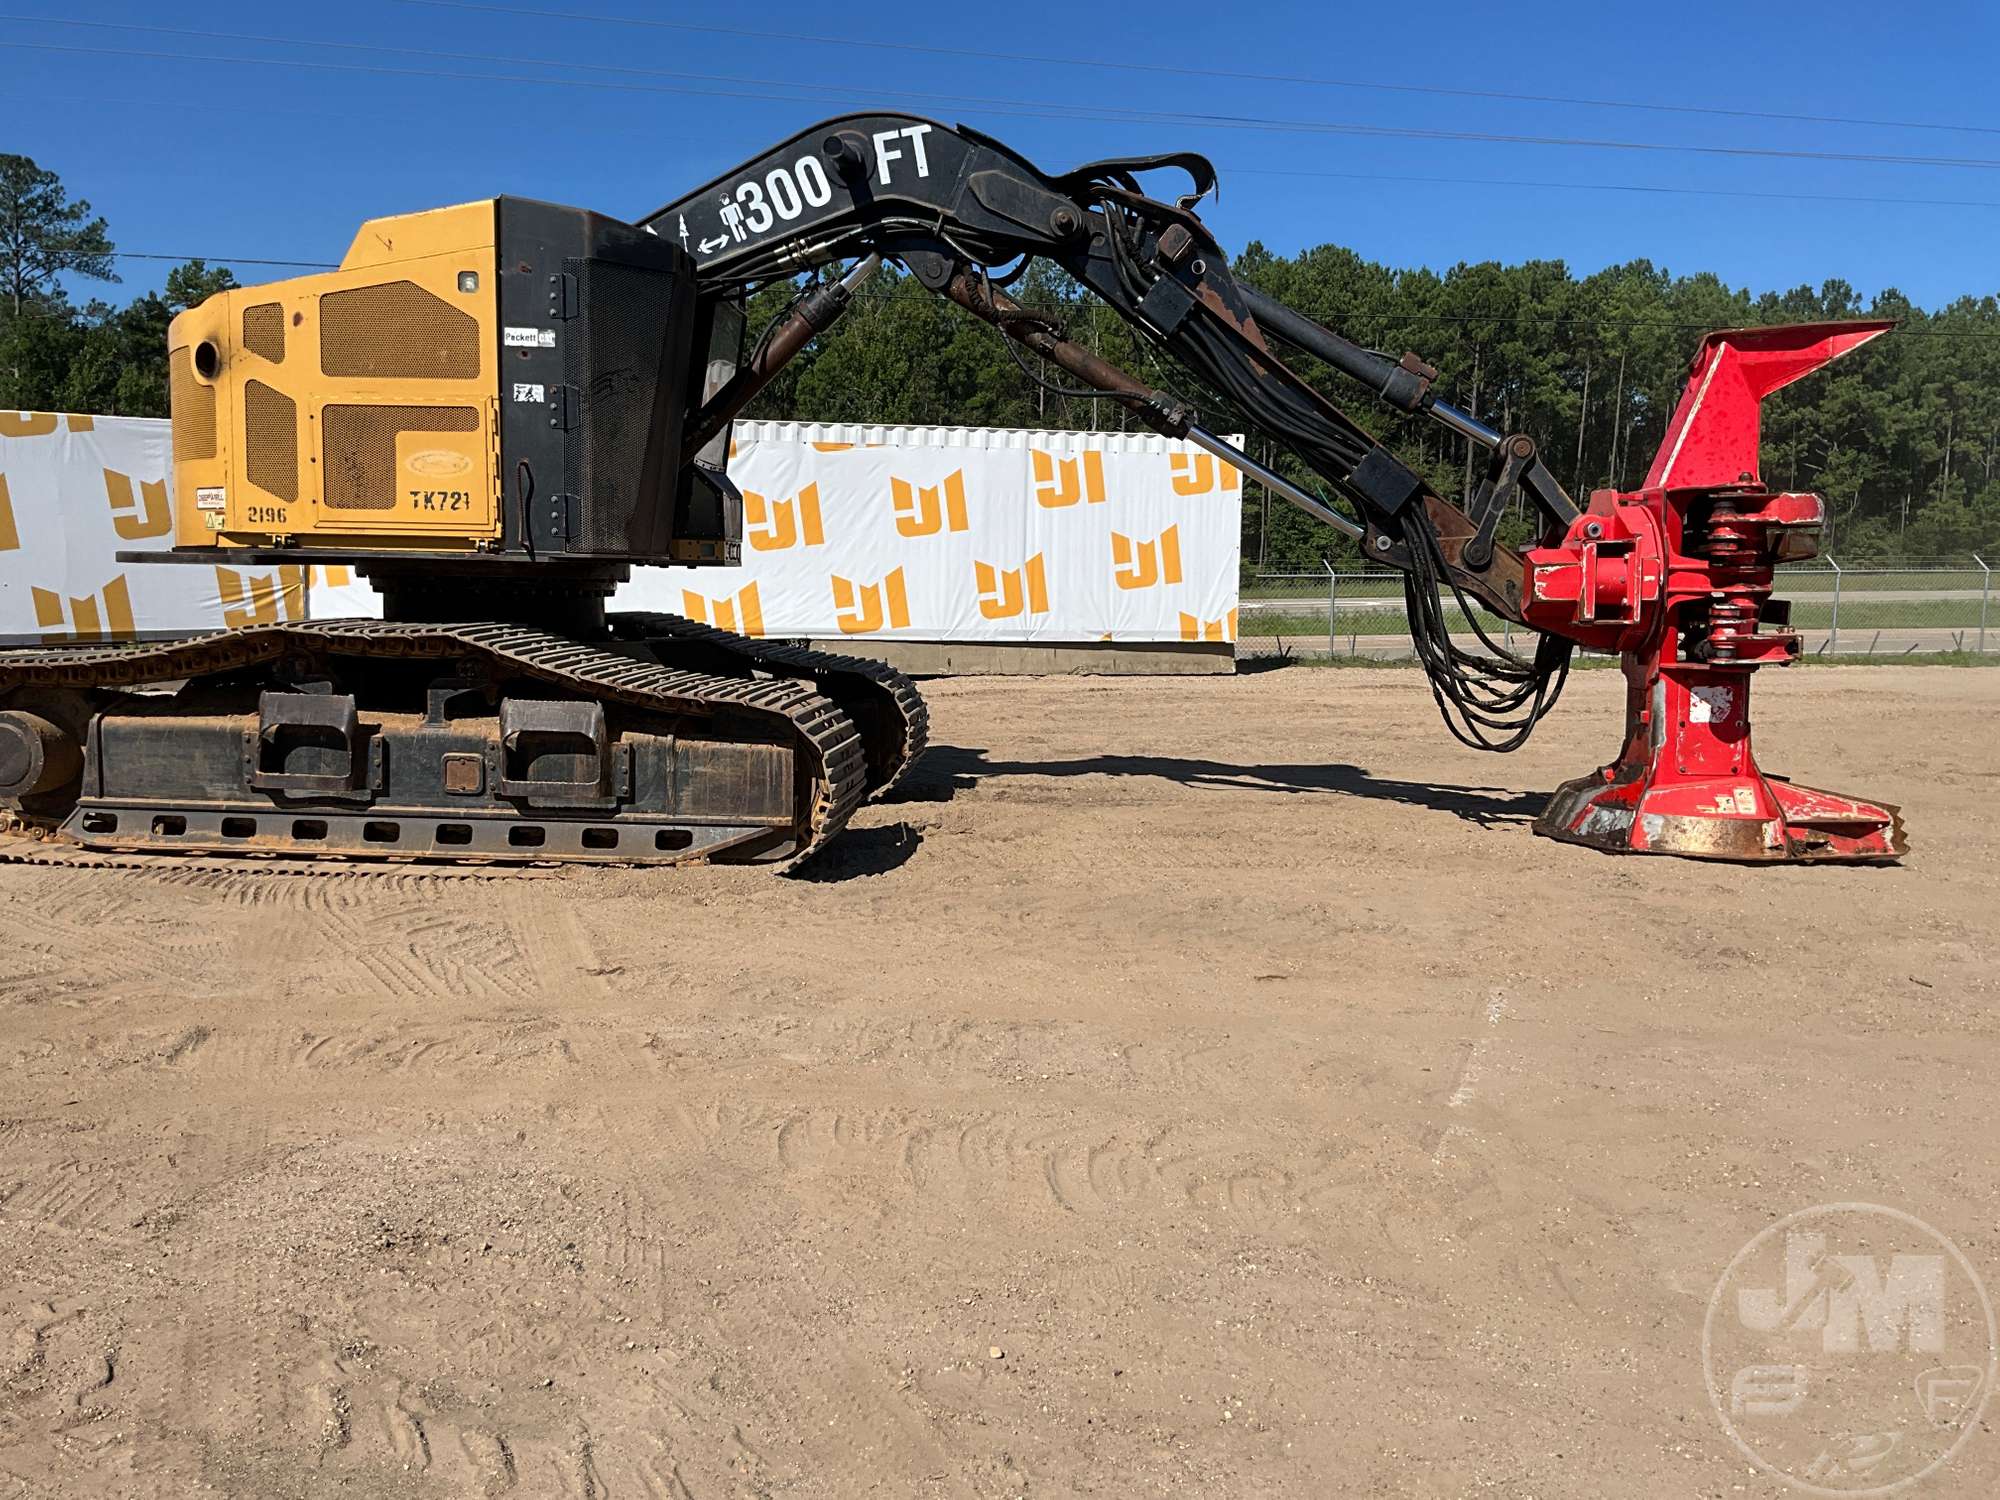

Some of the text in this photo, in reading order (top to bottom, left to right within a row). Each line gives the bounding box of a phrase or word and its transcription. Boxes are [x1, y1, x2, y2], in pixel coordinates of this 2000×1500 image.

[736, 124, 932, 234] 300 FT
[409, 491, 470, 511] TK721
[248, 506, 287, 523] 2196
